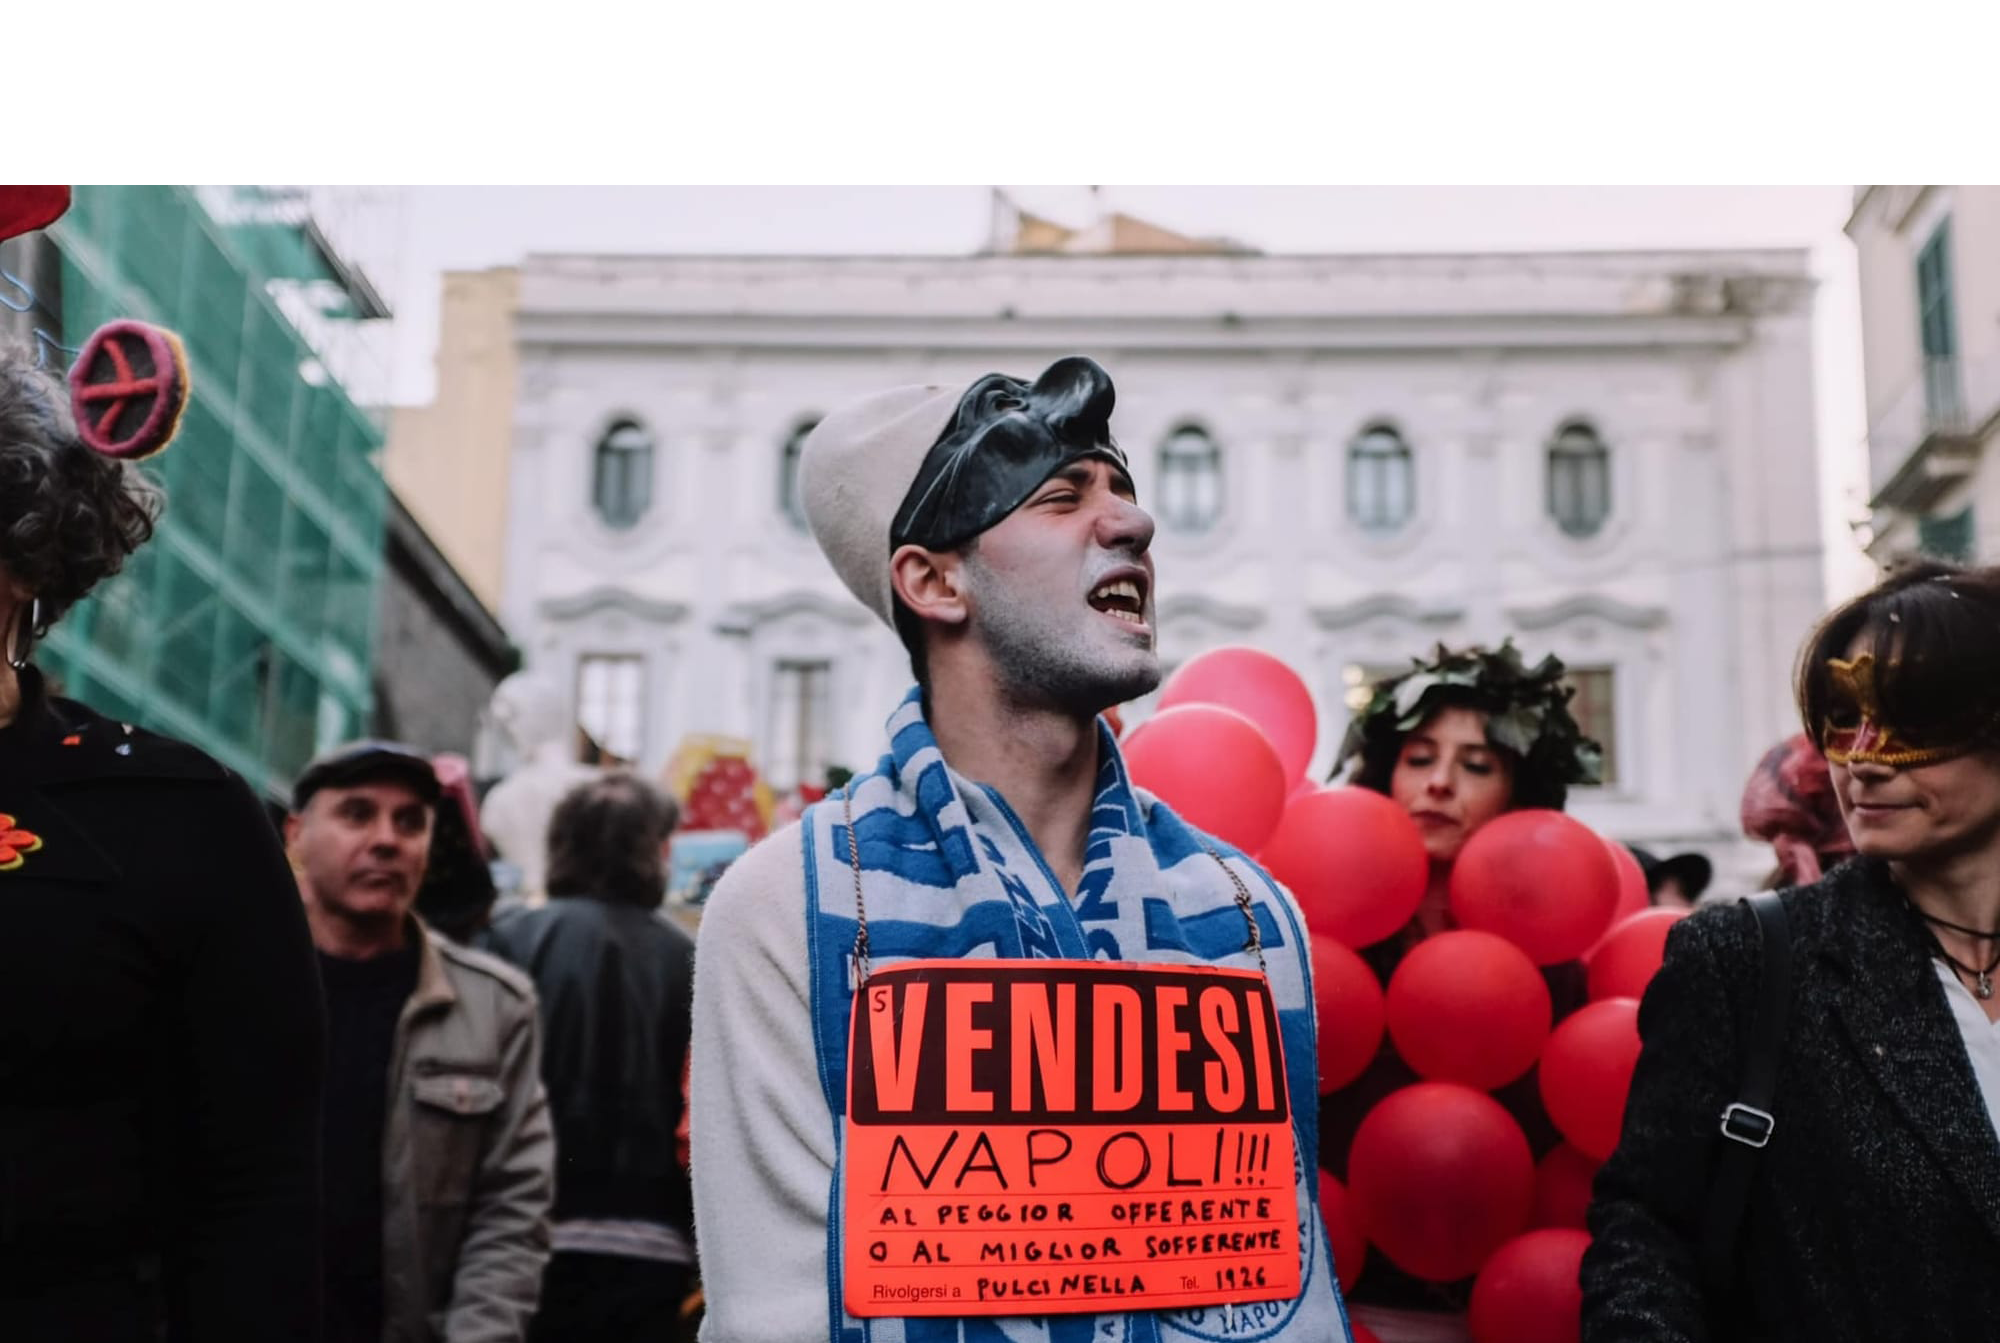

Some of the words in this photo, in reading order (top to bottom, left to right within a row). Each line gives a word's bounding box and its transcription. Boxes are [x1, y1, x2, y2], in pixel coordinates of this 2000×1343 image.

[868, 982, 1275, 1113] VENDESI
[880, 1127, 1270, 1192] NAPOLI!!!
[879, 1207, 917, 1226] AL
[937, 1202, 1075, 1225] PEGGIOR
[1111, 1197, 1271, 1226] OFFERENTE
[869, 1241, 888, 1263] O
[912, 1240, 951, 1264] AL
[979, 1237, 1122, 1263] MIGLIOR
[1145, 1228, 1281, 1259] SOFFERENTE
[873, 1284, 948, 1302] Rivolgersi
[952, 1289, 961, 1298] a
[976, 1274, 1146, 1301] PULCINELLA
[1180, 1275, 1200, 1290] Tel.
[1215, 1265, 1267, 1291] 1926
